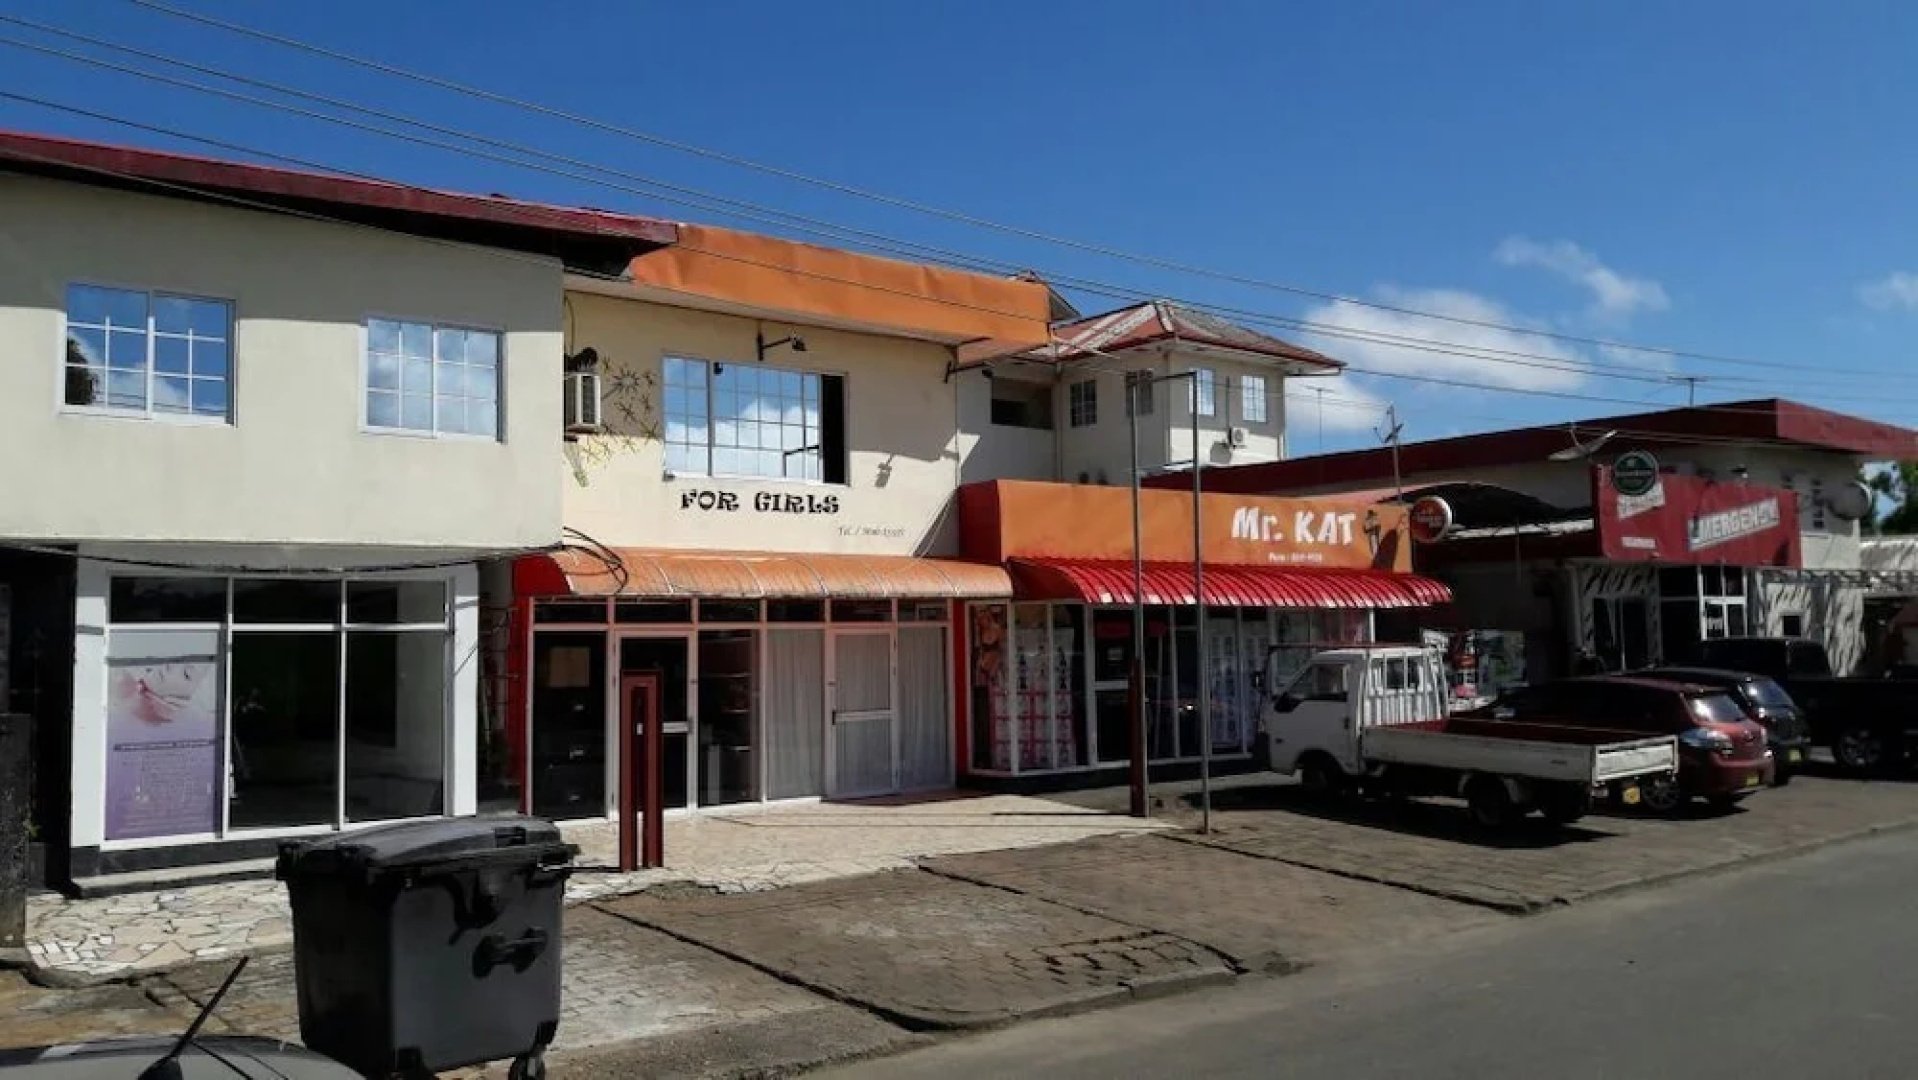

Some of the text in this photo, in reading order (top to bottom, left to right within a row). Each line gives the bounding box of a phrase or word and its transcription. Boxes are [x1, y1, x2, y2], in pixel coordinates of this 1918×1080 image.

[681, 489, 839, 514] FOR GIRLS
[1232, 507, 1356, 545] Mr. KAT
